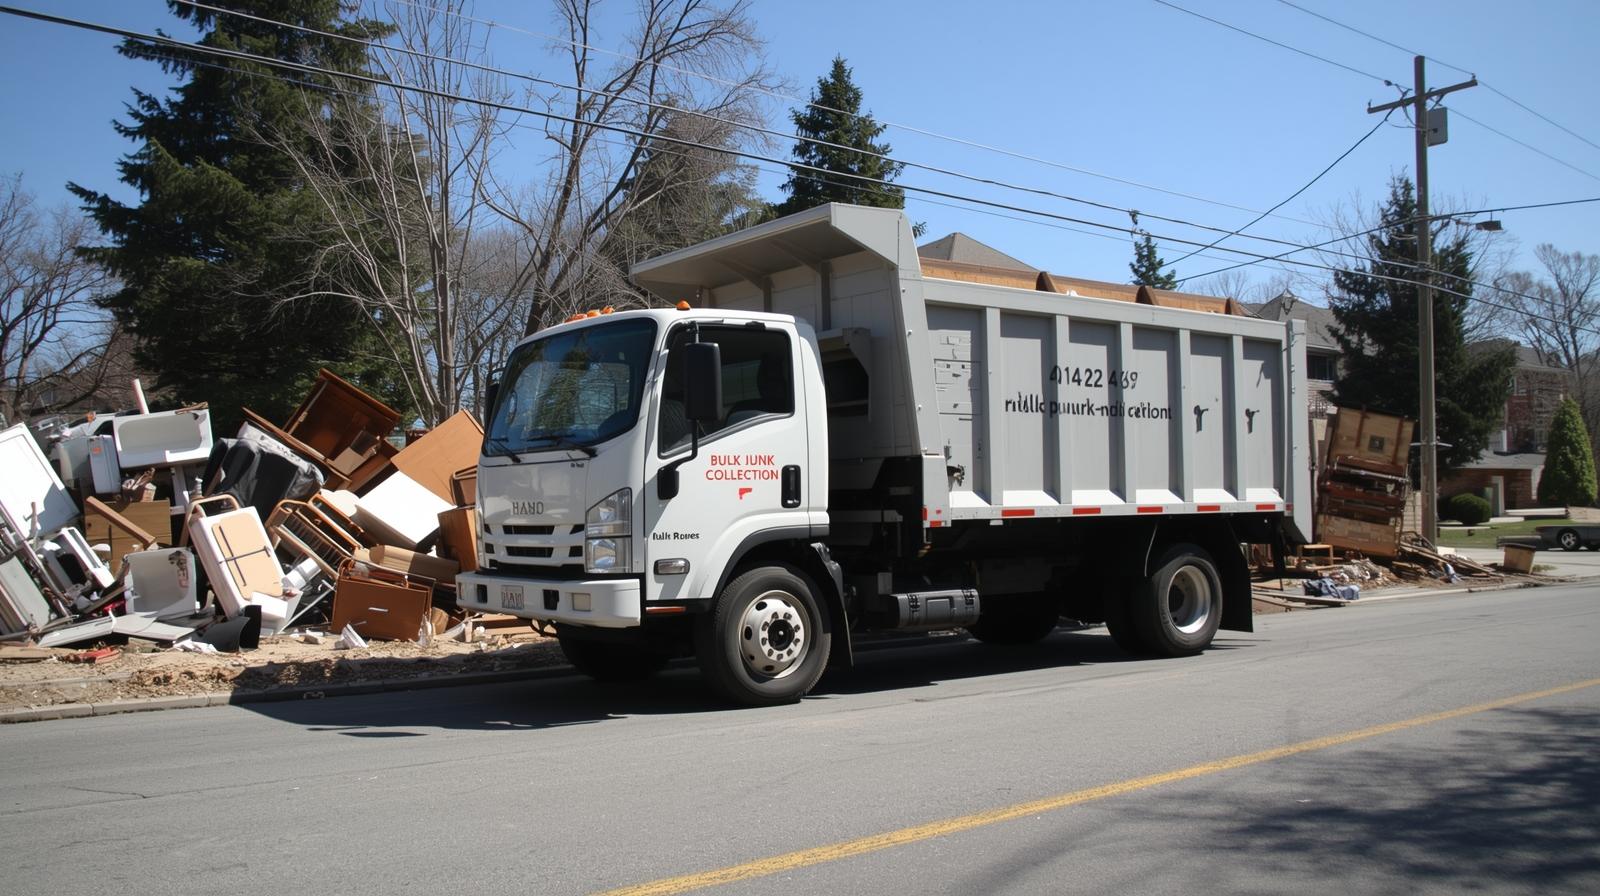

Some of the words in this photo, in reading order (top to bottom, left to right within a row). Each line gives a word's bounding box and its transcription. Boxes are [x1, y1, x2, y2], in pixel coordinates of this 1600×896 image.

[710, 455, 741, 466] BULK
[745, 455, 775, 466] JUNK
[705, 469, 779, 481] COLLECTION
